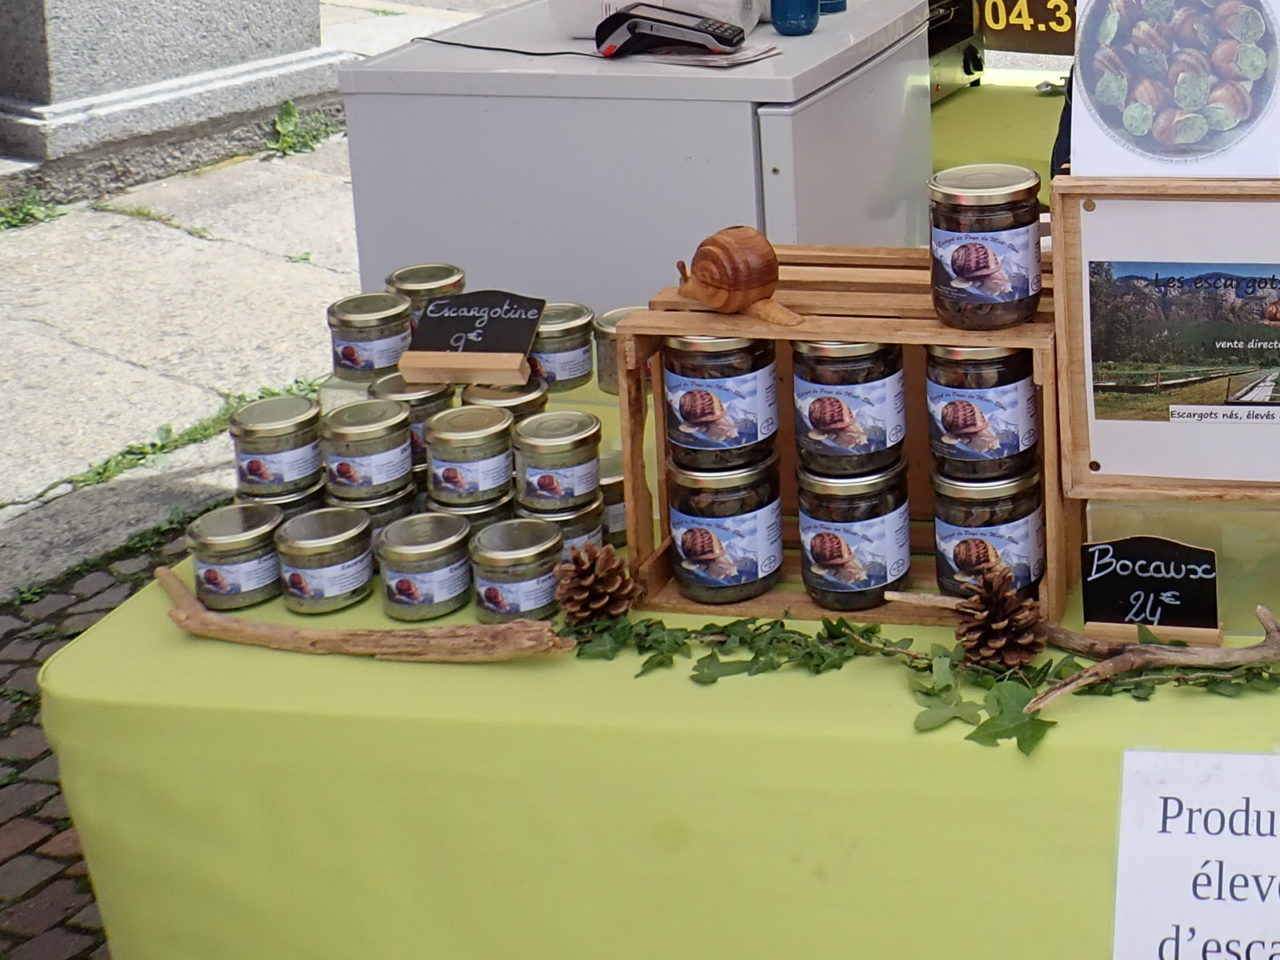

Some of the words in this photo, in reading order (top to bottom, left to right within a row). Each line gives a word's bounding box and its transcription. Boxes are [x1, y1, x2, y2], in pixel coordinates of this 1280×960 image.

[1153, 273, 1185, 290] Les
[426, 299, 539, 328] Escargotine
[1215, 340, 1245, 349] vente
[1170, 410, 1218, 421] Escargots
[1222, 410, 1242, 420] nés,
[1246, 410, 1276, 420] élevés
[1087, 544, 1216, 581] Bocaux
[1125, 590, 1181, 626] 24€
